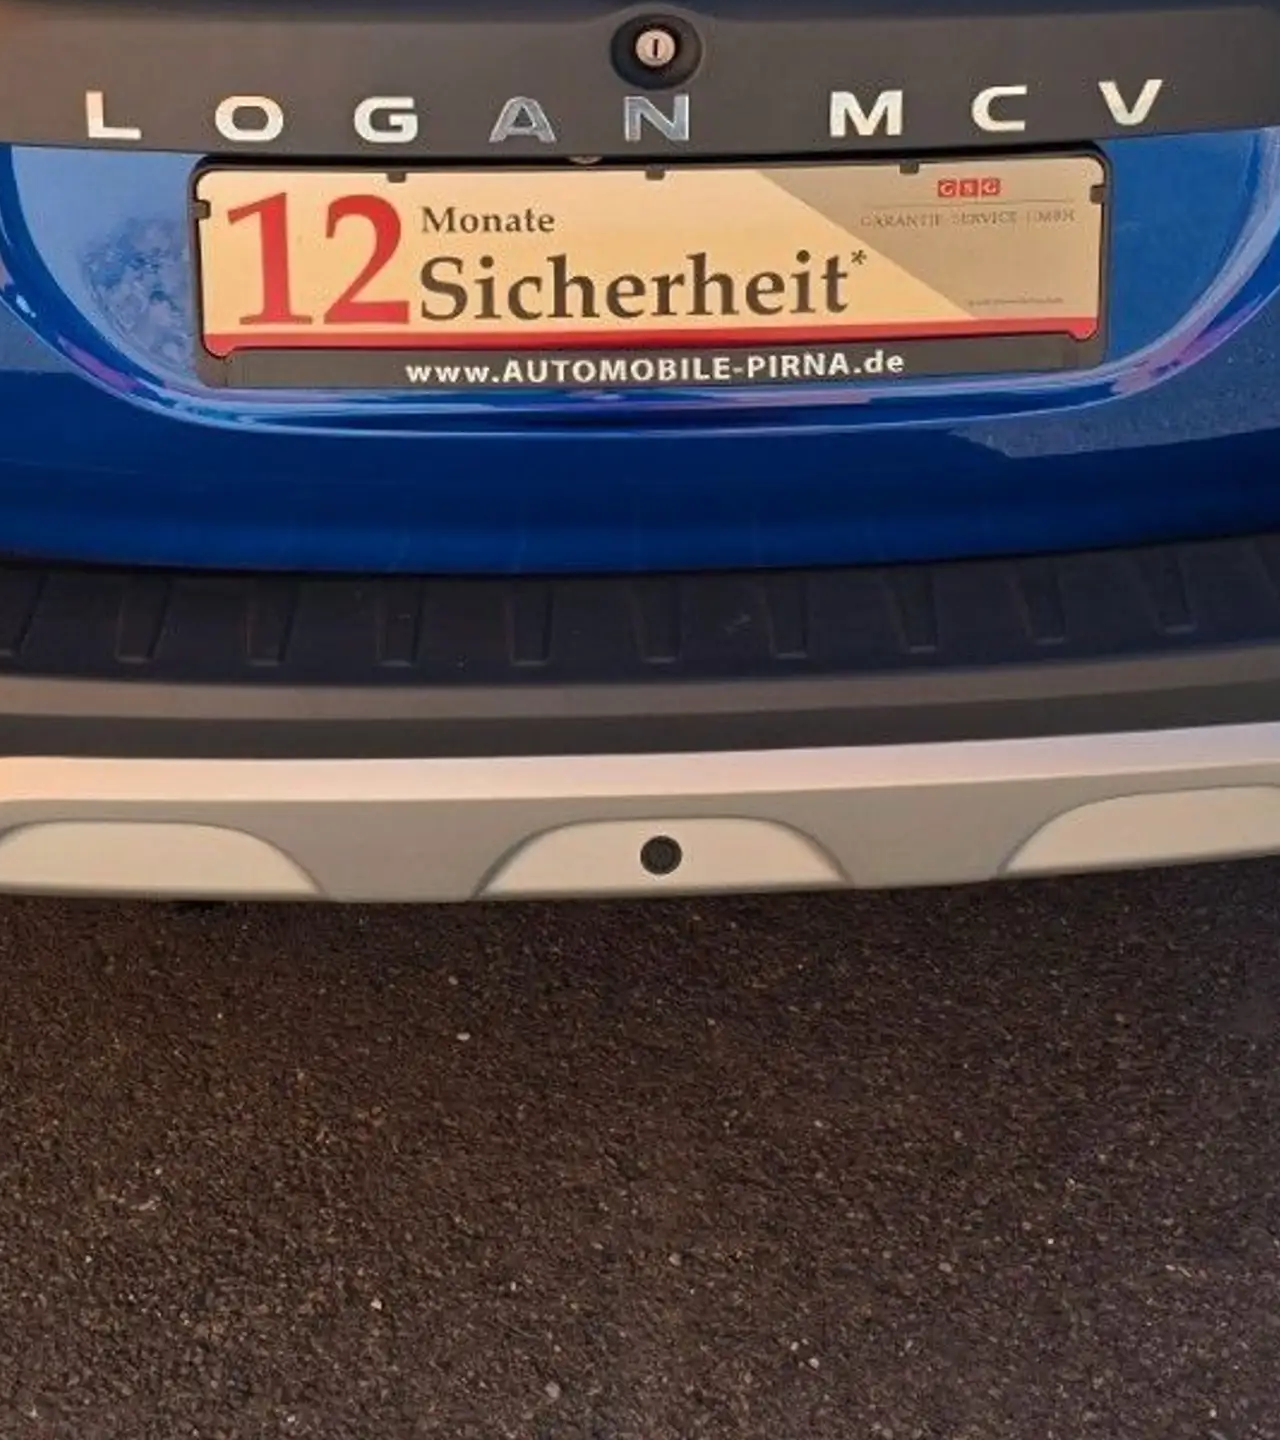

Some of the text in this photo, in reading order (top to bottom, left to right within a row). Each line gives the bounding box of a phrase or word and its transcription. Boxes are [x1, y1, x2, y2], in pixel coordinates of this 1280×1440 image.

[85, 78, 1163, 144] LOGAN MCV
[421, 205, 556, 234] Monate
[227, 191, 410, 325] 12
[406, 348, 906, 384] www.AUTOMOBILE-PIRNA.de
